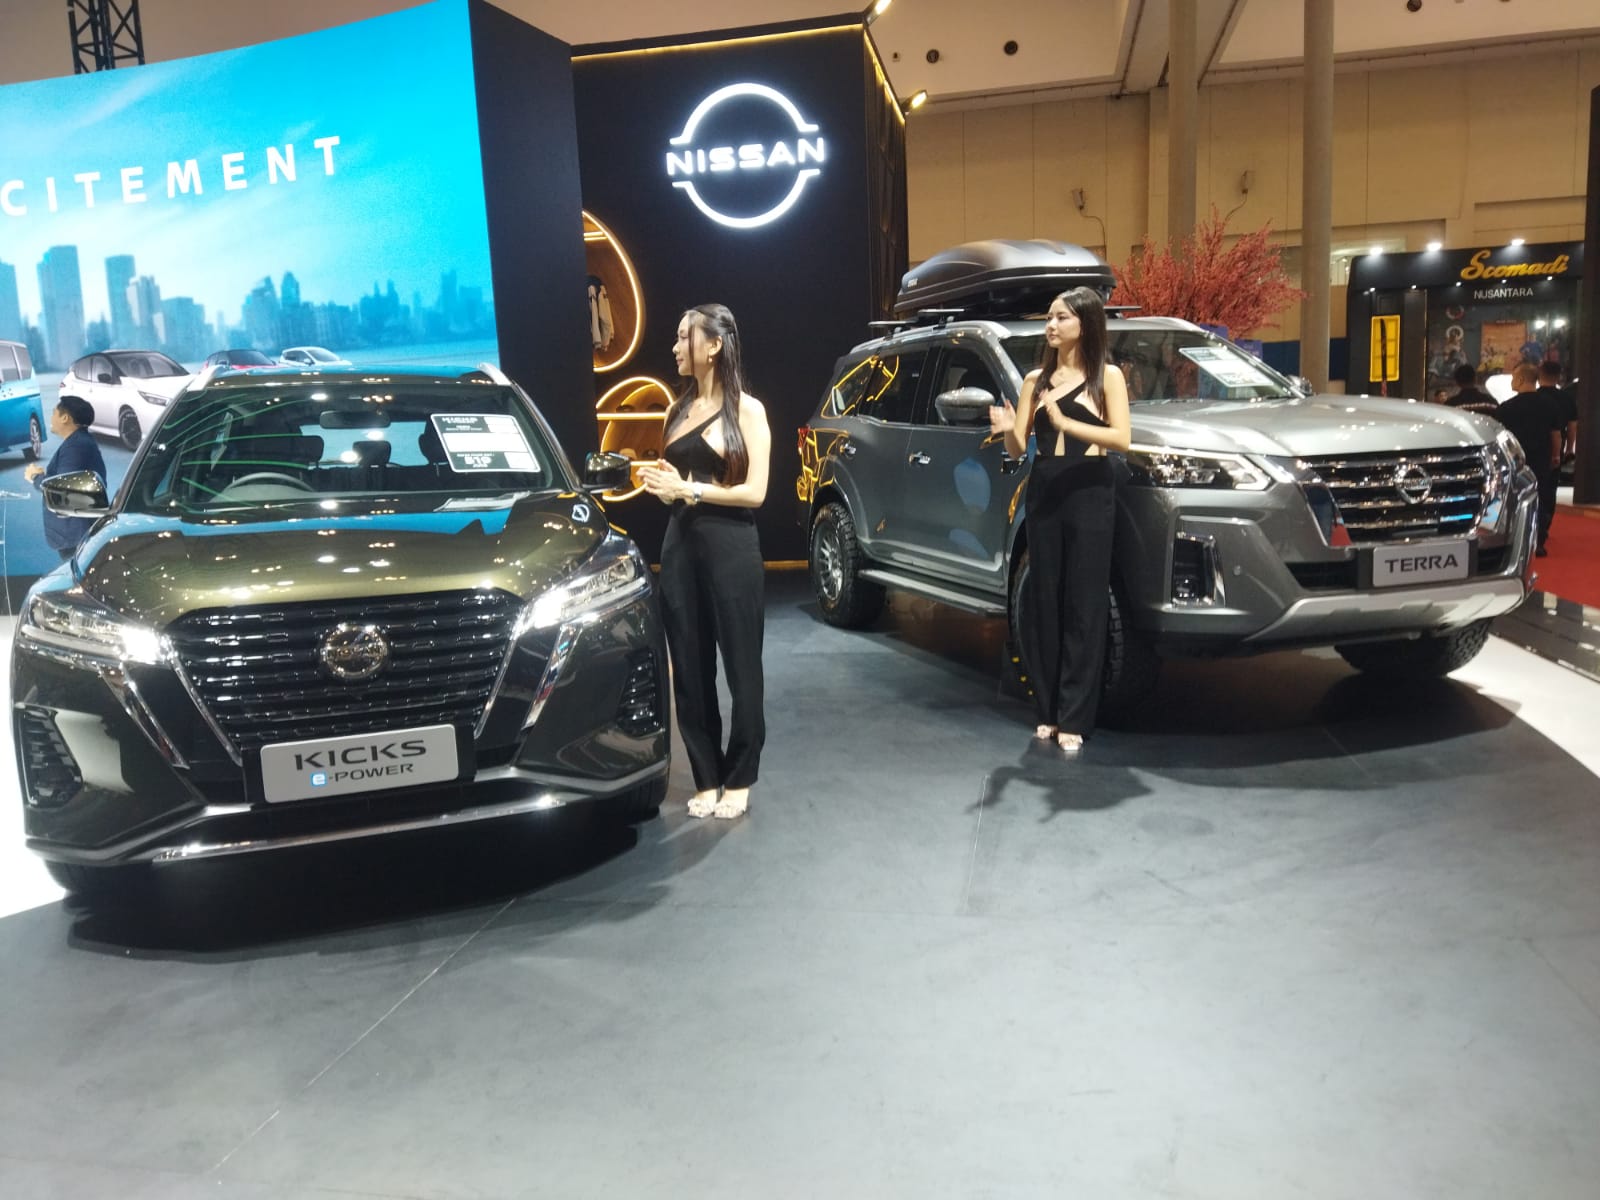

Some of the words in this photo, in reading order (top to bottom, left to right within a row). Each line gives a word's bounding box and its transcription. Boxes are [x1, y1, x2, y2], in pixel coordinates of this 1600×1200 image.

[666, 137, 825, 176] NISSAN
[1, 136, 340, 216] CITEMENT
[1461, 250, 1569, 279] Scomadi
[1474, 287, 1534, 299] NUSANTARA
[1385, 554, 1458, 573] TERRA
[294, 740, 427, 770] KICKS
[311, 763, 414, 787] e-POWER
